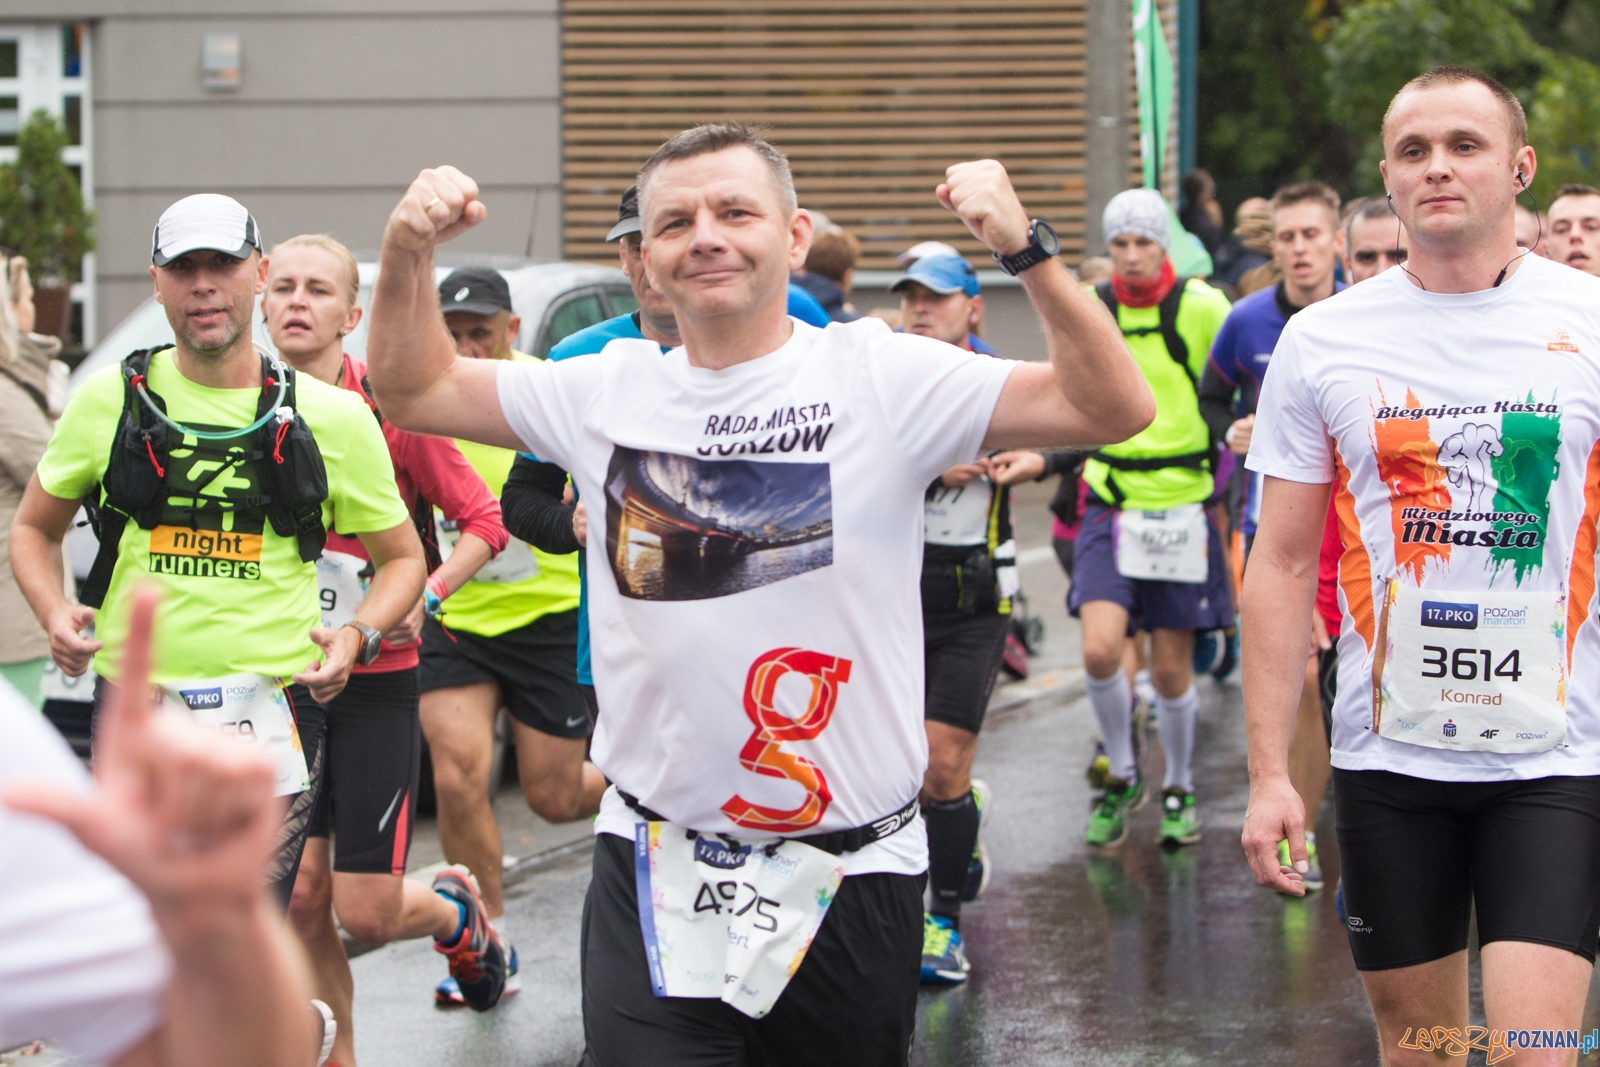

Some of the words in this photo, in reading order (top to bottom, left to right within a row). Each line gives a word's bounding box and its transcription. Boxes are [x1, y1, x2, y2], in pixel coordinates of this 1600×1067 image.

[1376, 404, 1488, 421] Biegająca
[1493, 400, 1560, 414] Kasta
[704, 415, 759, 436] RADA
[1401, 507, 1540, 526] Miedziowego
[173, 531, 243, 556] night
[1402, 520, 1540, 548] Miasta
[150, 554, 261, 580] runners
[1483, 616, 1526, 626] maraton
[1421, 644, 1523, 682] 3614
[1441, 688, 1503, 706] Konrad
[693, 880, 780, 932] 4975
